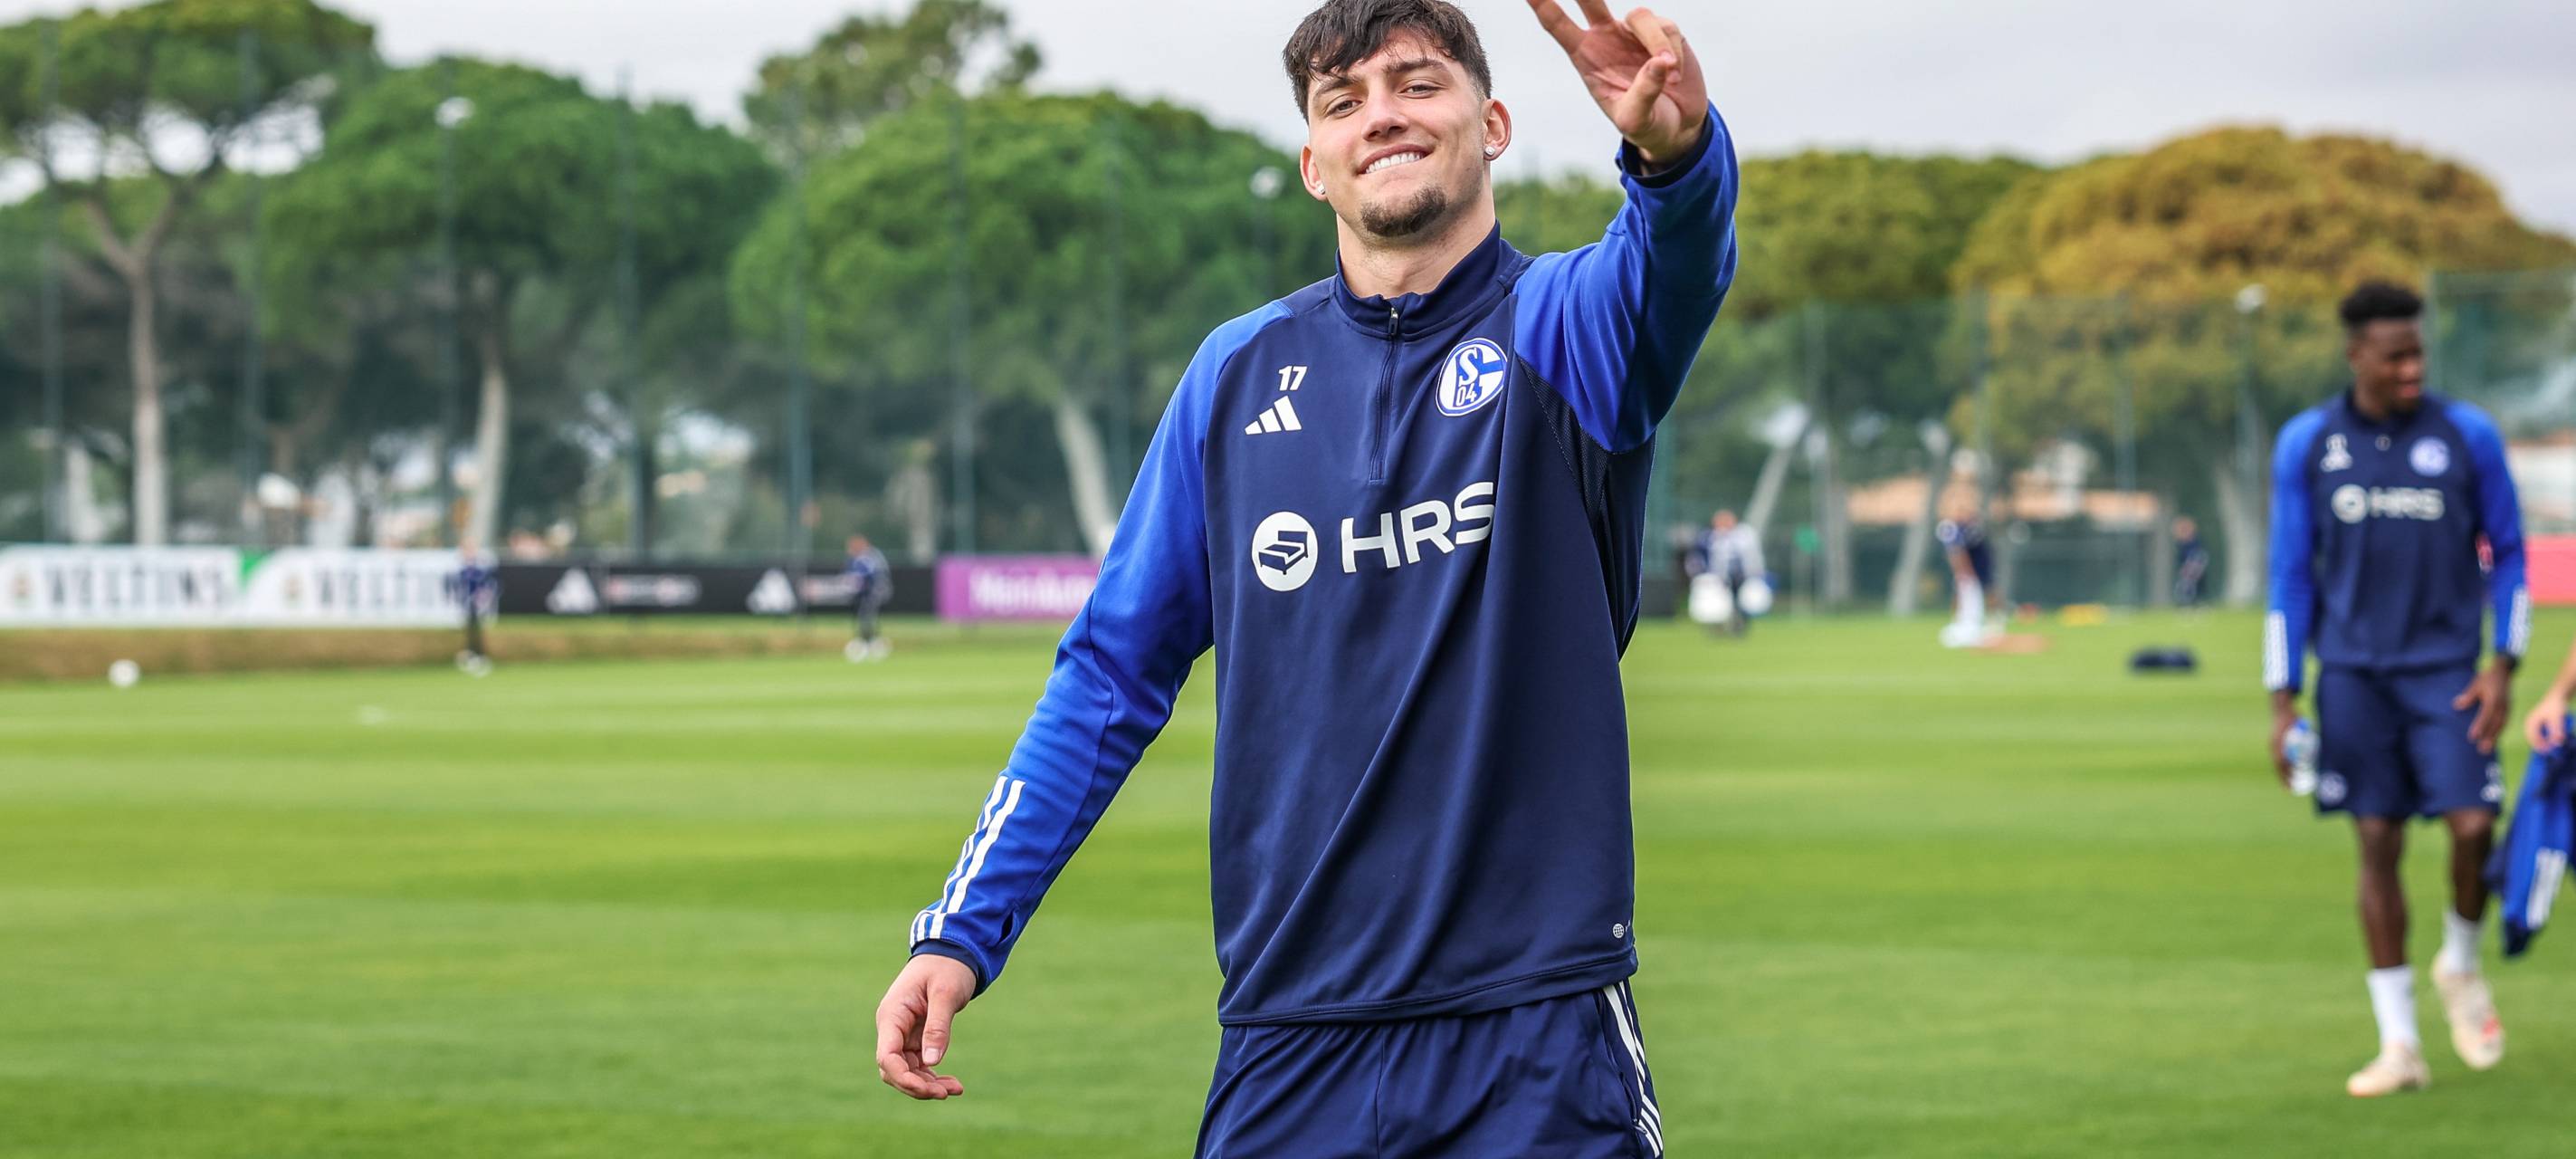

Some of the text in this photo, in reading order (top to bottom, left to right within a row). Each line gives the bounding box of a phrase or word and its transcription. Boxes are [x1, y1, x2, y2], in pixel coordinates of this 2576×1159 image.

[1277, 365, 1308, 391] 17
[1458, 347, 1479, 388] S
[1455, 382, 1478, 407] 04
[2369, 486, 2445, 521] HRS
[1340, 481, 1495, 573] HRS
